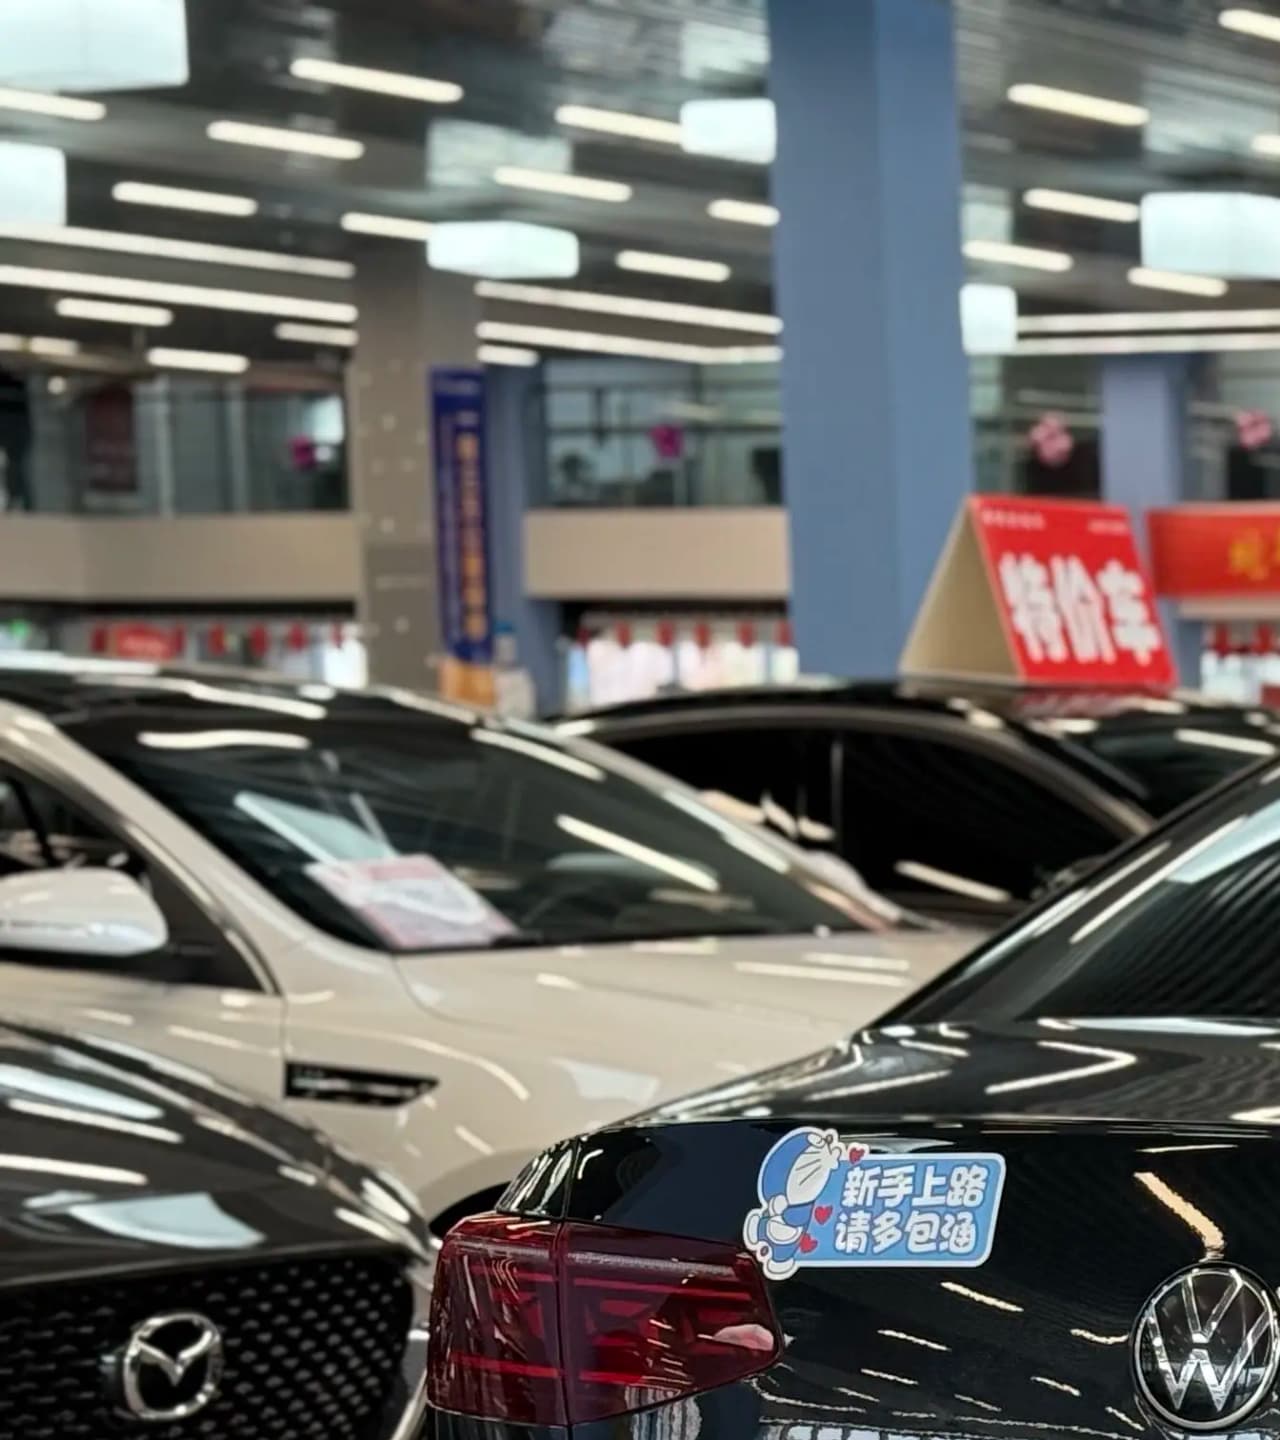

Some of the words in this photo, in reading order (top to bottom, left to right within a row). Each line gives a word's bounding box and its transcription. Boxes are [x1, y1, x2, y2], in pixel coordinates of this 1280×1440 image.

[999, 552, 1161, 666] 特价车
[841, 1163, 987, 1209] 新手上路
[834, 1210, 980, 1257] 请多包涵
